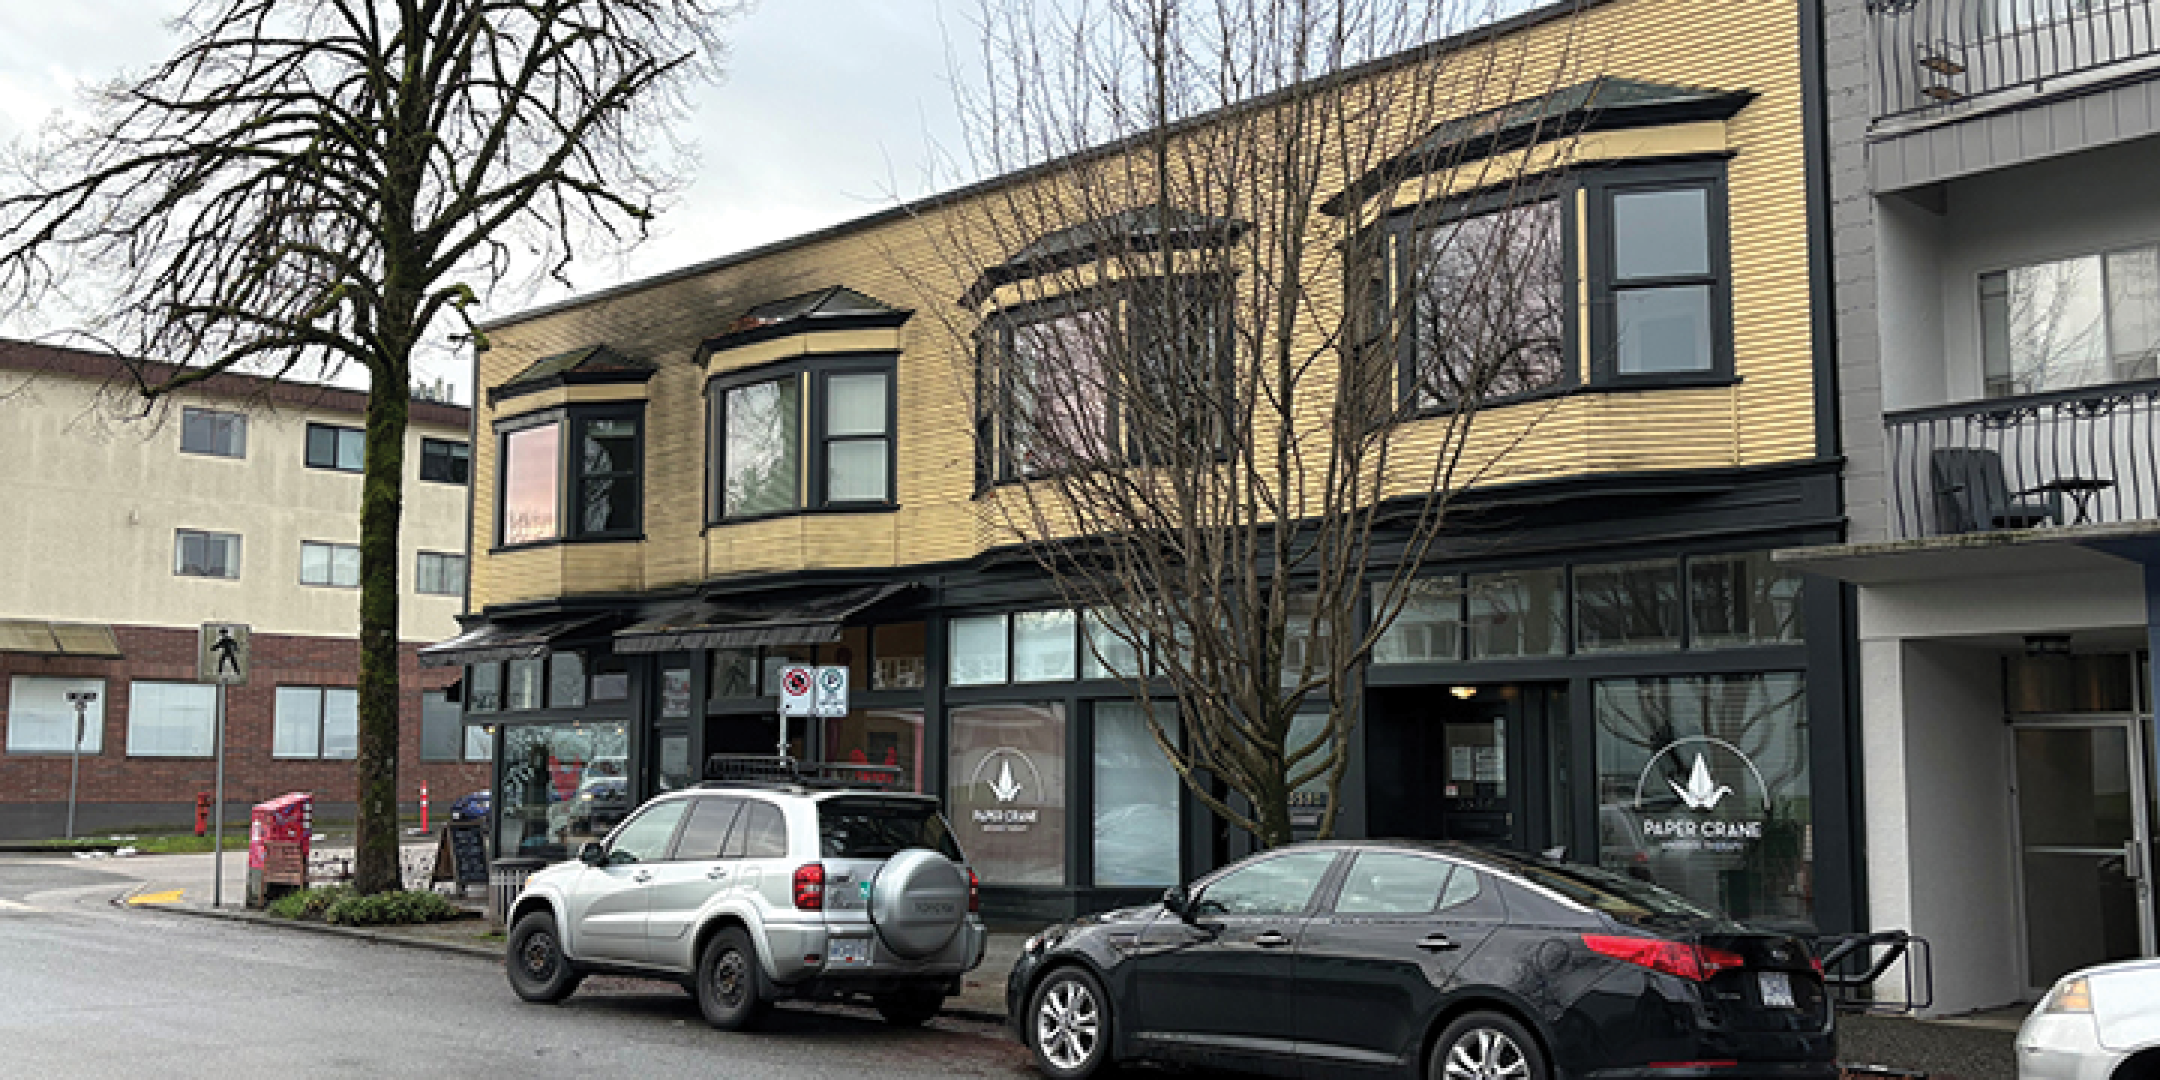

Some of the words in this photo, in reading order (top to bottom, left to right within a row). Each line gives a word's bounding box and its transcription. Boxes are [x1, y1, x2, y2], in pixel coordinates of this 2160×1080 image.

[972, 809, 1003, 822] PAPER
[1005, 809, 1037, 822] CRANE
[1643, 819, 1697, 837] PAPER
[1701, 820, 1761, 838] CRANE
